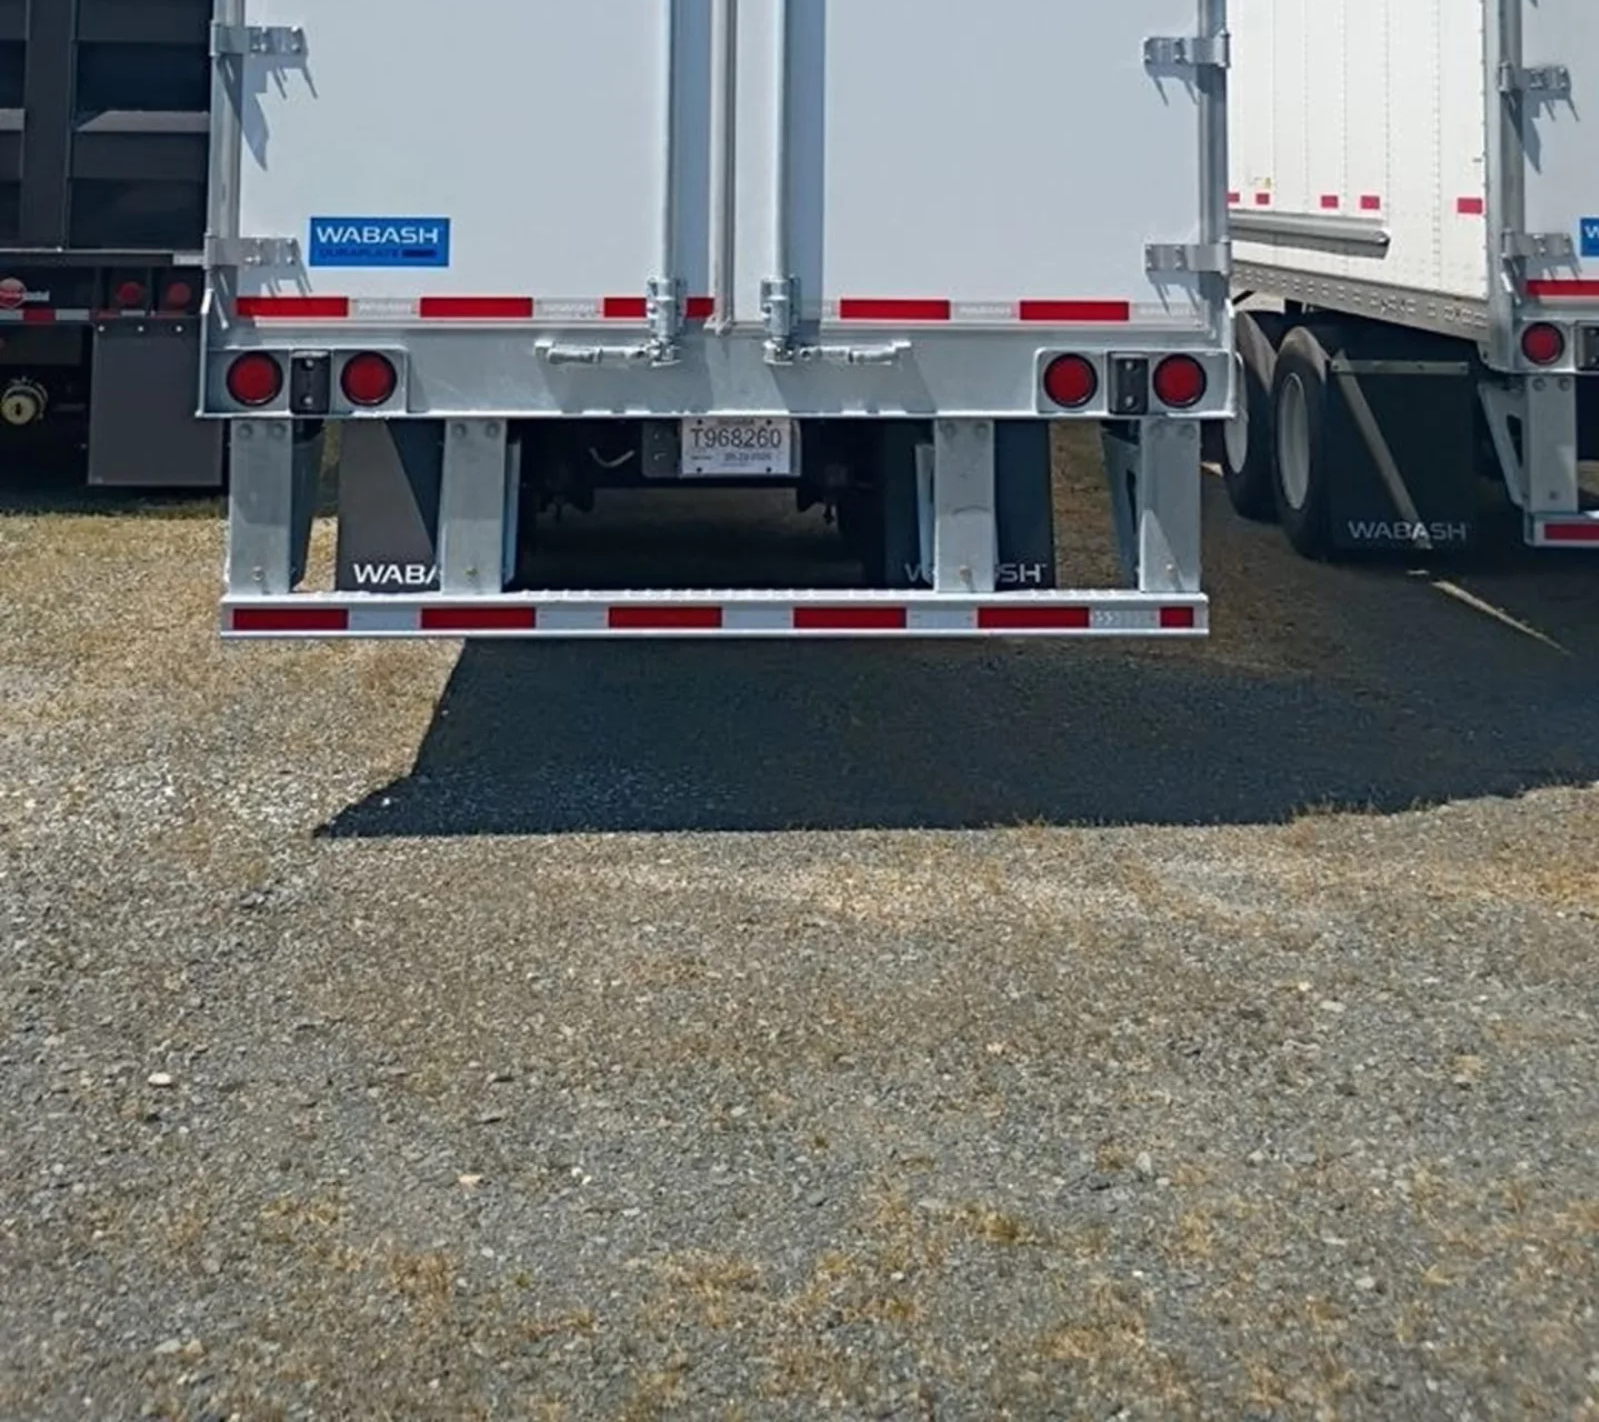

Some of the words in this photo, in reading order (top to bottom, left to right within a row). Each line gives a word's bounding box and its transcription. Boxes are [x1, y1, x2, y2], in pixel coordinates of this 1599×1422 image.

[316, 226, 439, 244] WABASH
[690, 428, 782, 448] T968260
[1347, 520, 1467, 540] WABASH
